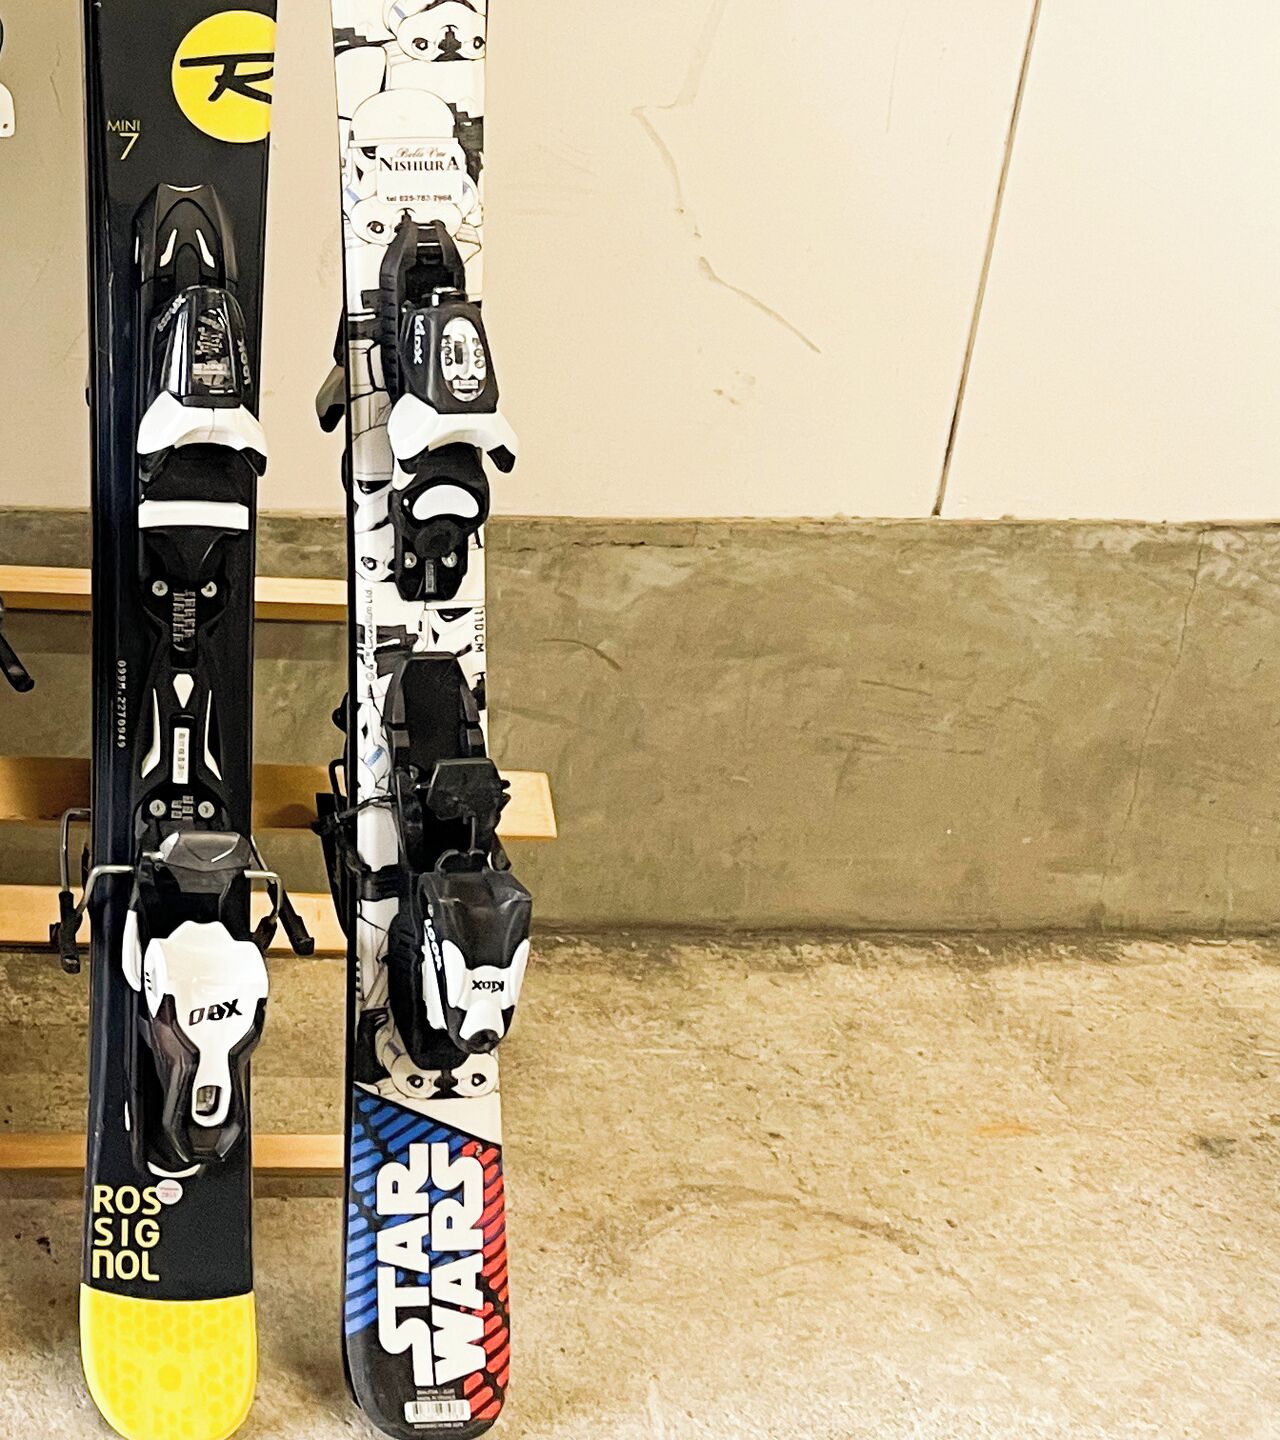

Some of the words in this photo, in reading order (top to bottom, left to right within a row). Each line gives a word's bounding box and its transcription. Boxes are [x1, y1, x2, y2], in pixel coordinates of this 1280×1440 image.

[106, 119, 141, 131] MINI
[119, 132, 140, 160] 7
[474, 610, 485, 632] 110
[474, 634, 485, 654] CM
[93, 1185, 162, 1214] ROS
[92, 1218, 161, 1248] SIG
[376, 1142, 430, 1388] STAR
[429, 1142, 487, 1387] WARS
